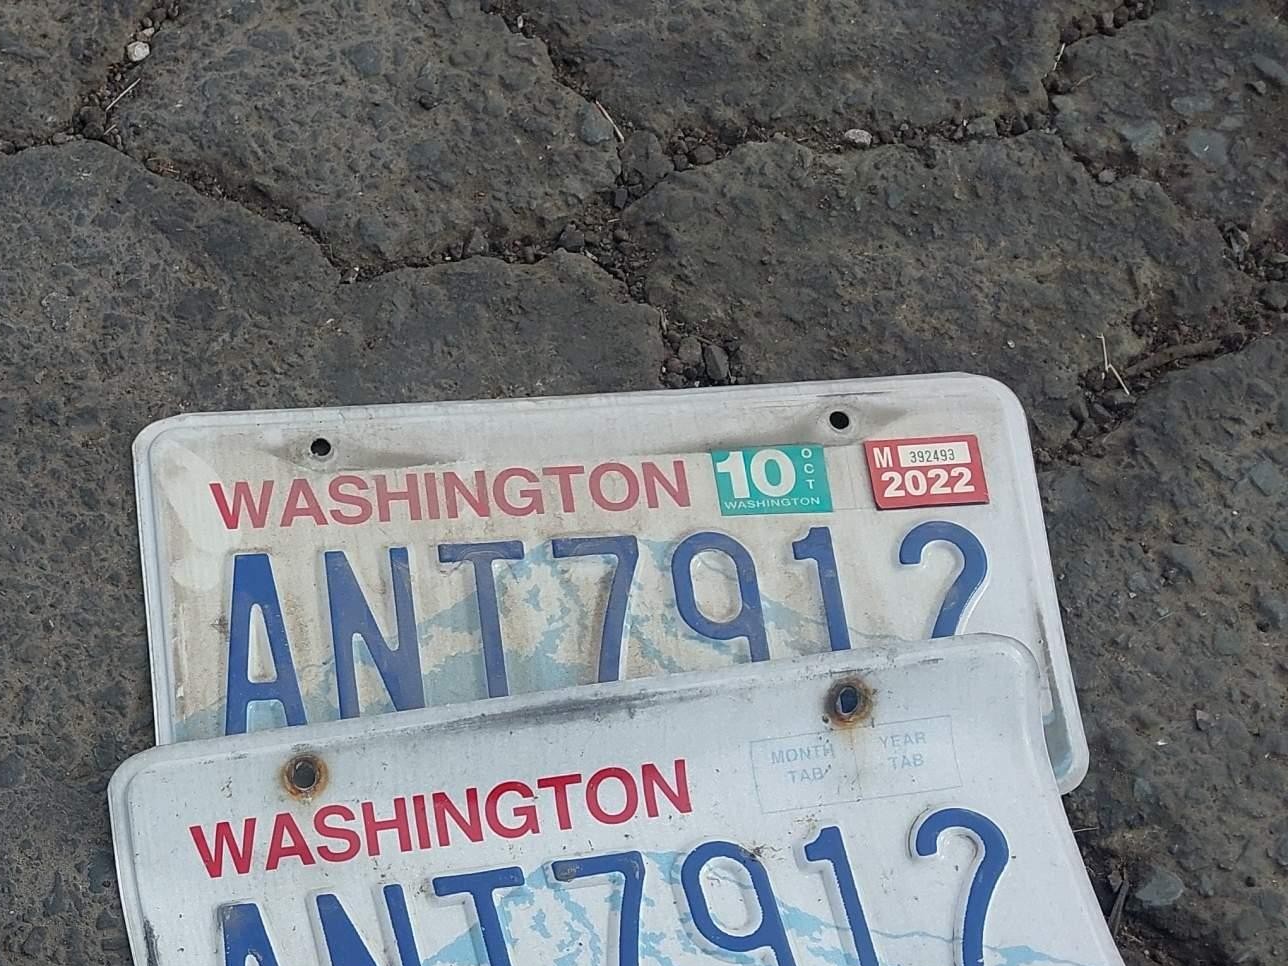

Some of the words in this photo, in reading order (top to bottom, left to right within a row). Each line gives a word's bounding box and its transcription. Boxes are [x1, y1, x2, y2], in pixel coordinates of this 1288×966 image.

[872, 446, 894, 469] M
[909, 448, 956, 464] 392493
[716, 448, 796, 499] 10
[801, 448, 815, 490] OCT
[880, 467, 976, 498] 2022
[208, 459, 691, 531] WASHINGTON
[724, 496, 821, 511] WASHINGTON
[224, 519, 988, 737] ANT7912
[878, 730, 928, 749] YEAR
[770, 743, 836, 765] MONTH
[887, 753, 925, 771] TAB
[787, 766, 827, 785] TAB
[189, 758, 694, 879] WASHINGTON
